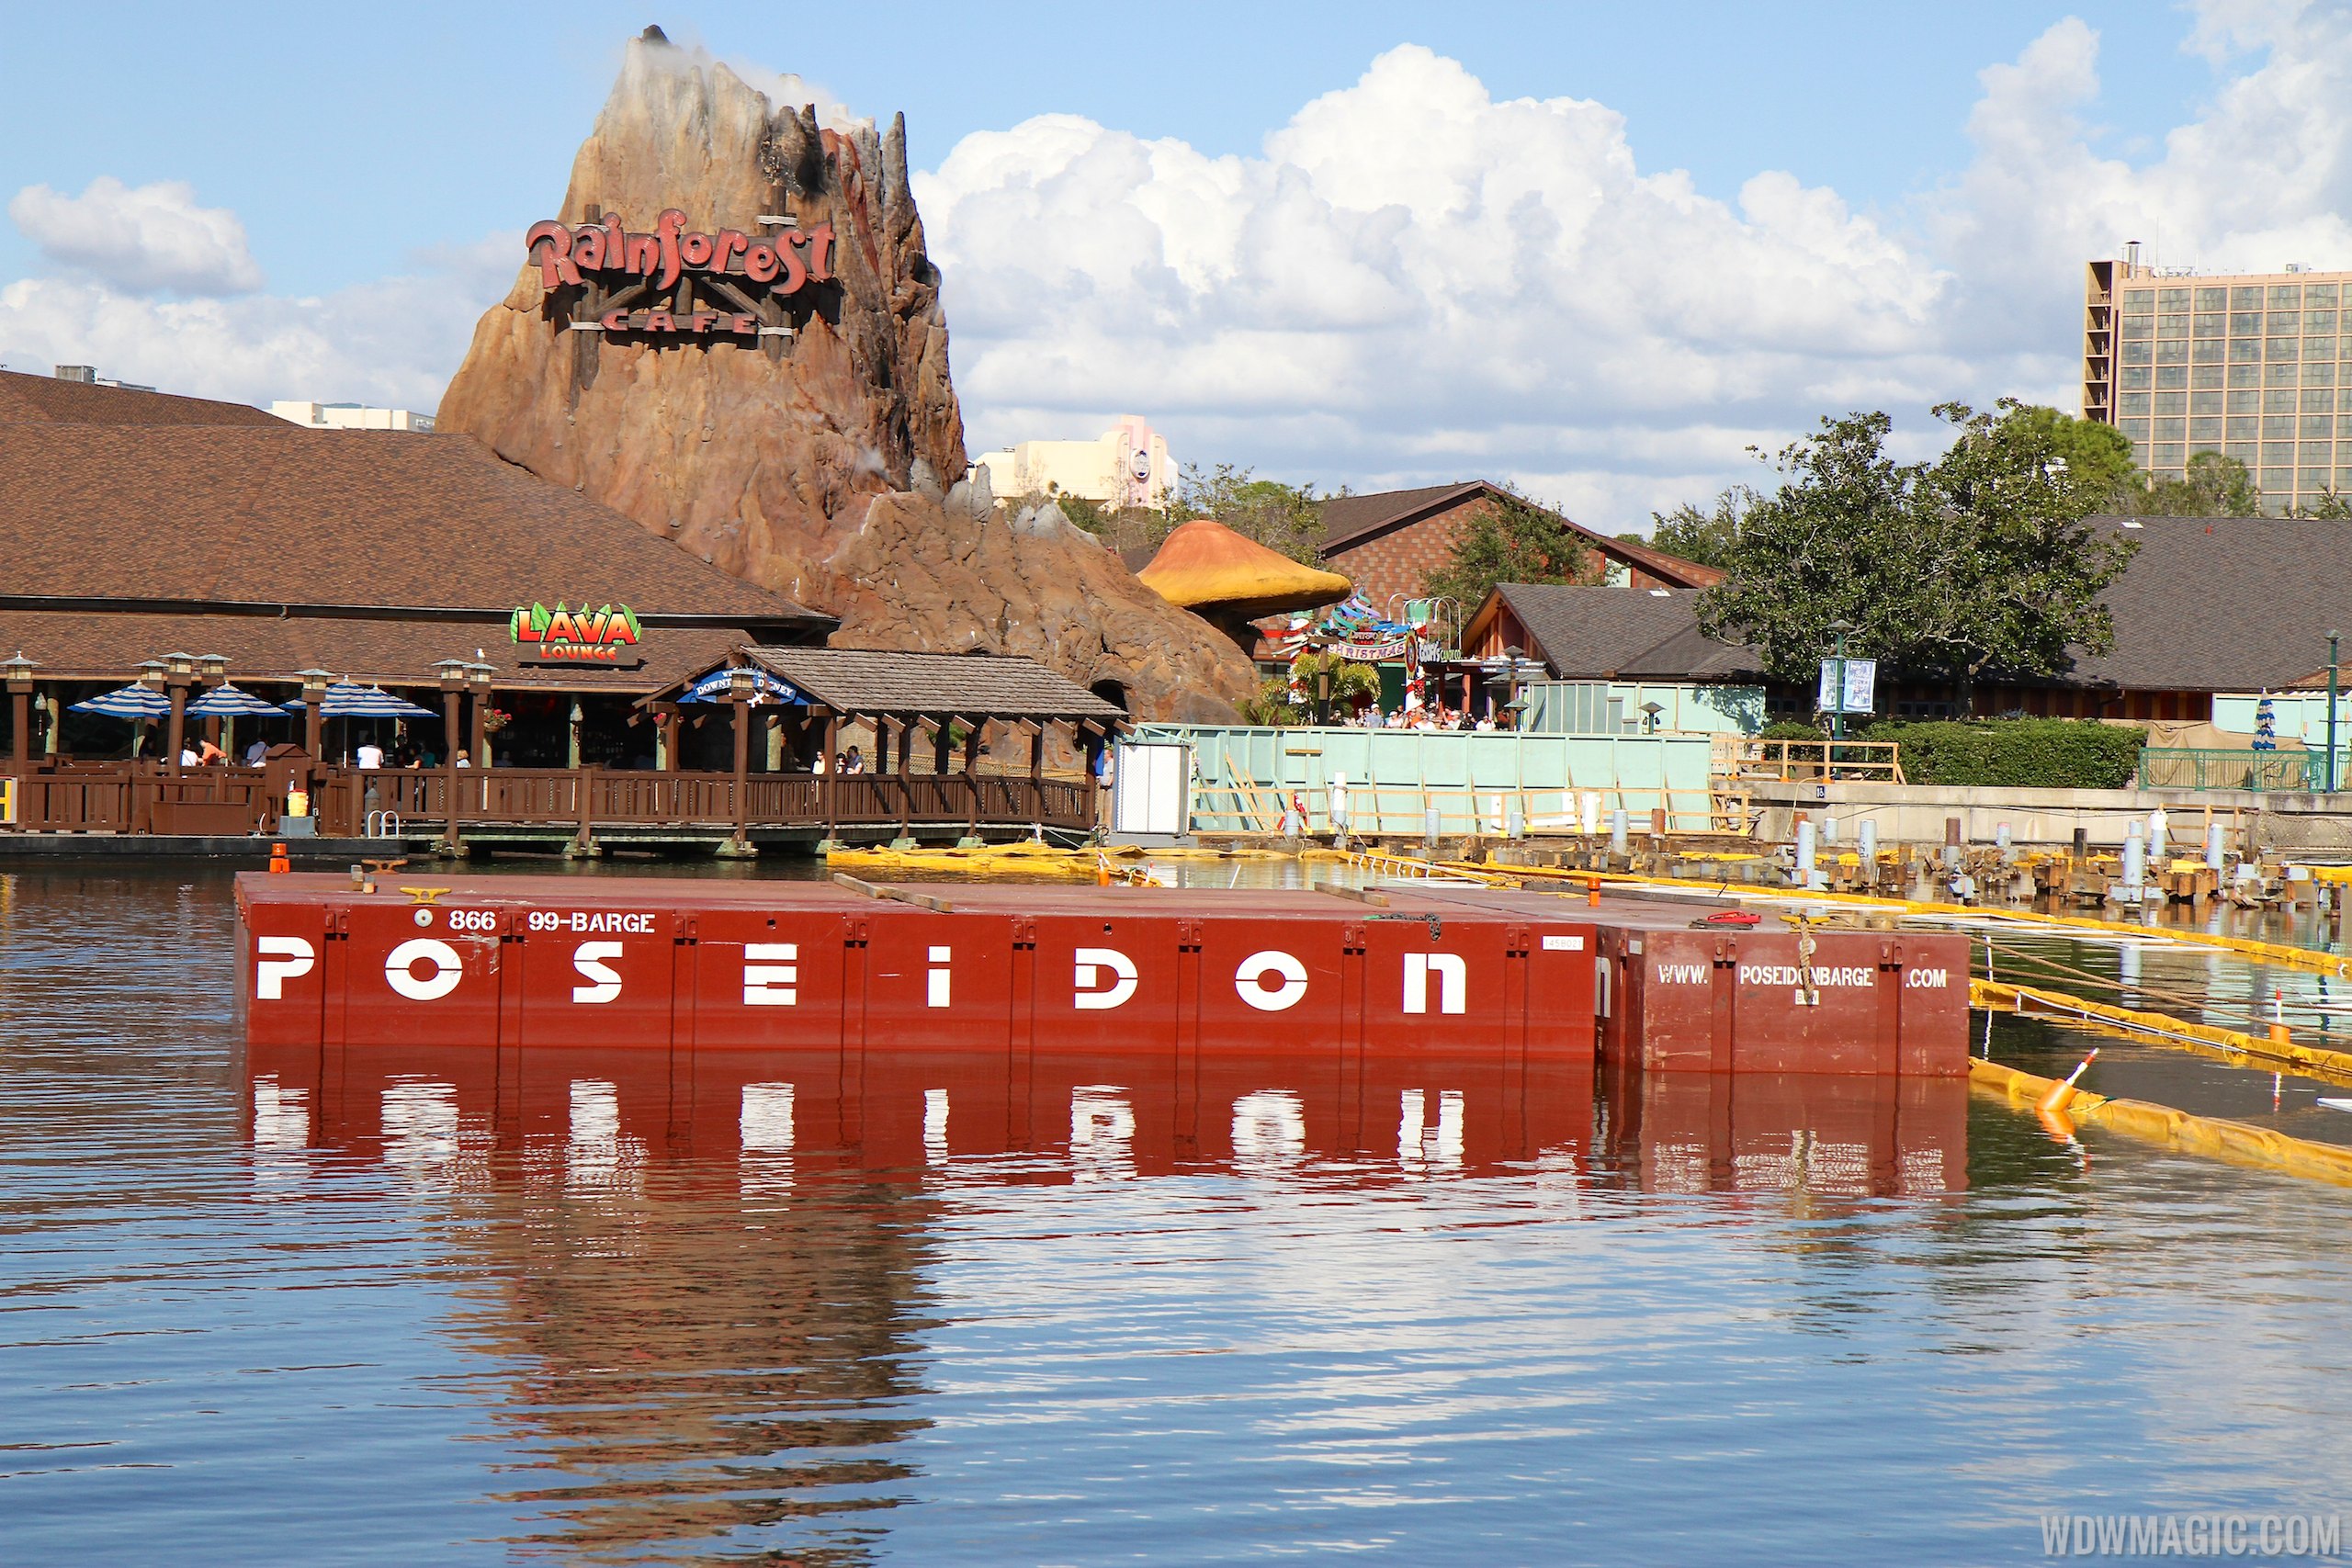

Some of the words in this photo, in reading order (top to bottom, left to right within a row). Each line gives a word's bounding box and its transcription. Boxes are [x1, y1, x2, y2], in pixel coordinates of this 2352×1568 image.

[526, 208, 837, 296] Rainforest
[602, 307, 757, 335] CAFE
[517, 609, 638, 645] LAVA
[539, 644, 617, 660] LOUNGE
[449, 909, 496, 931] 866
[528, 911, 655, 933] 99-BARGE
[1657, 964, 1708, 985] WWW.
[1905, 968, 1947, 988] .COM
